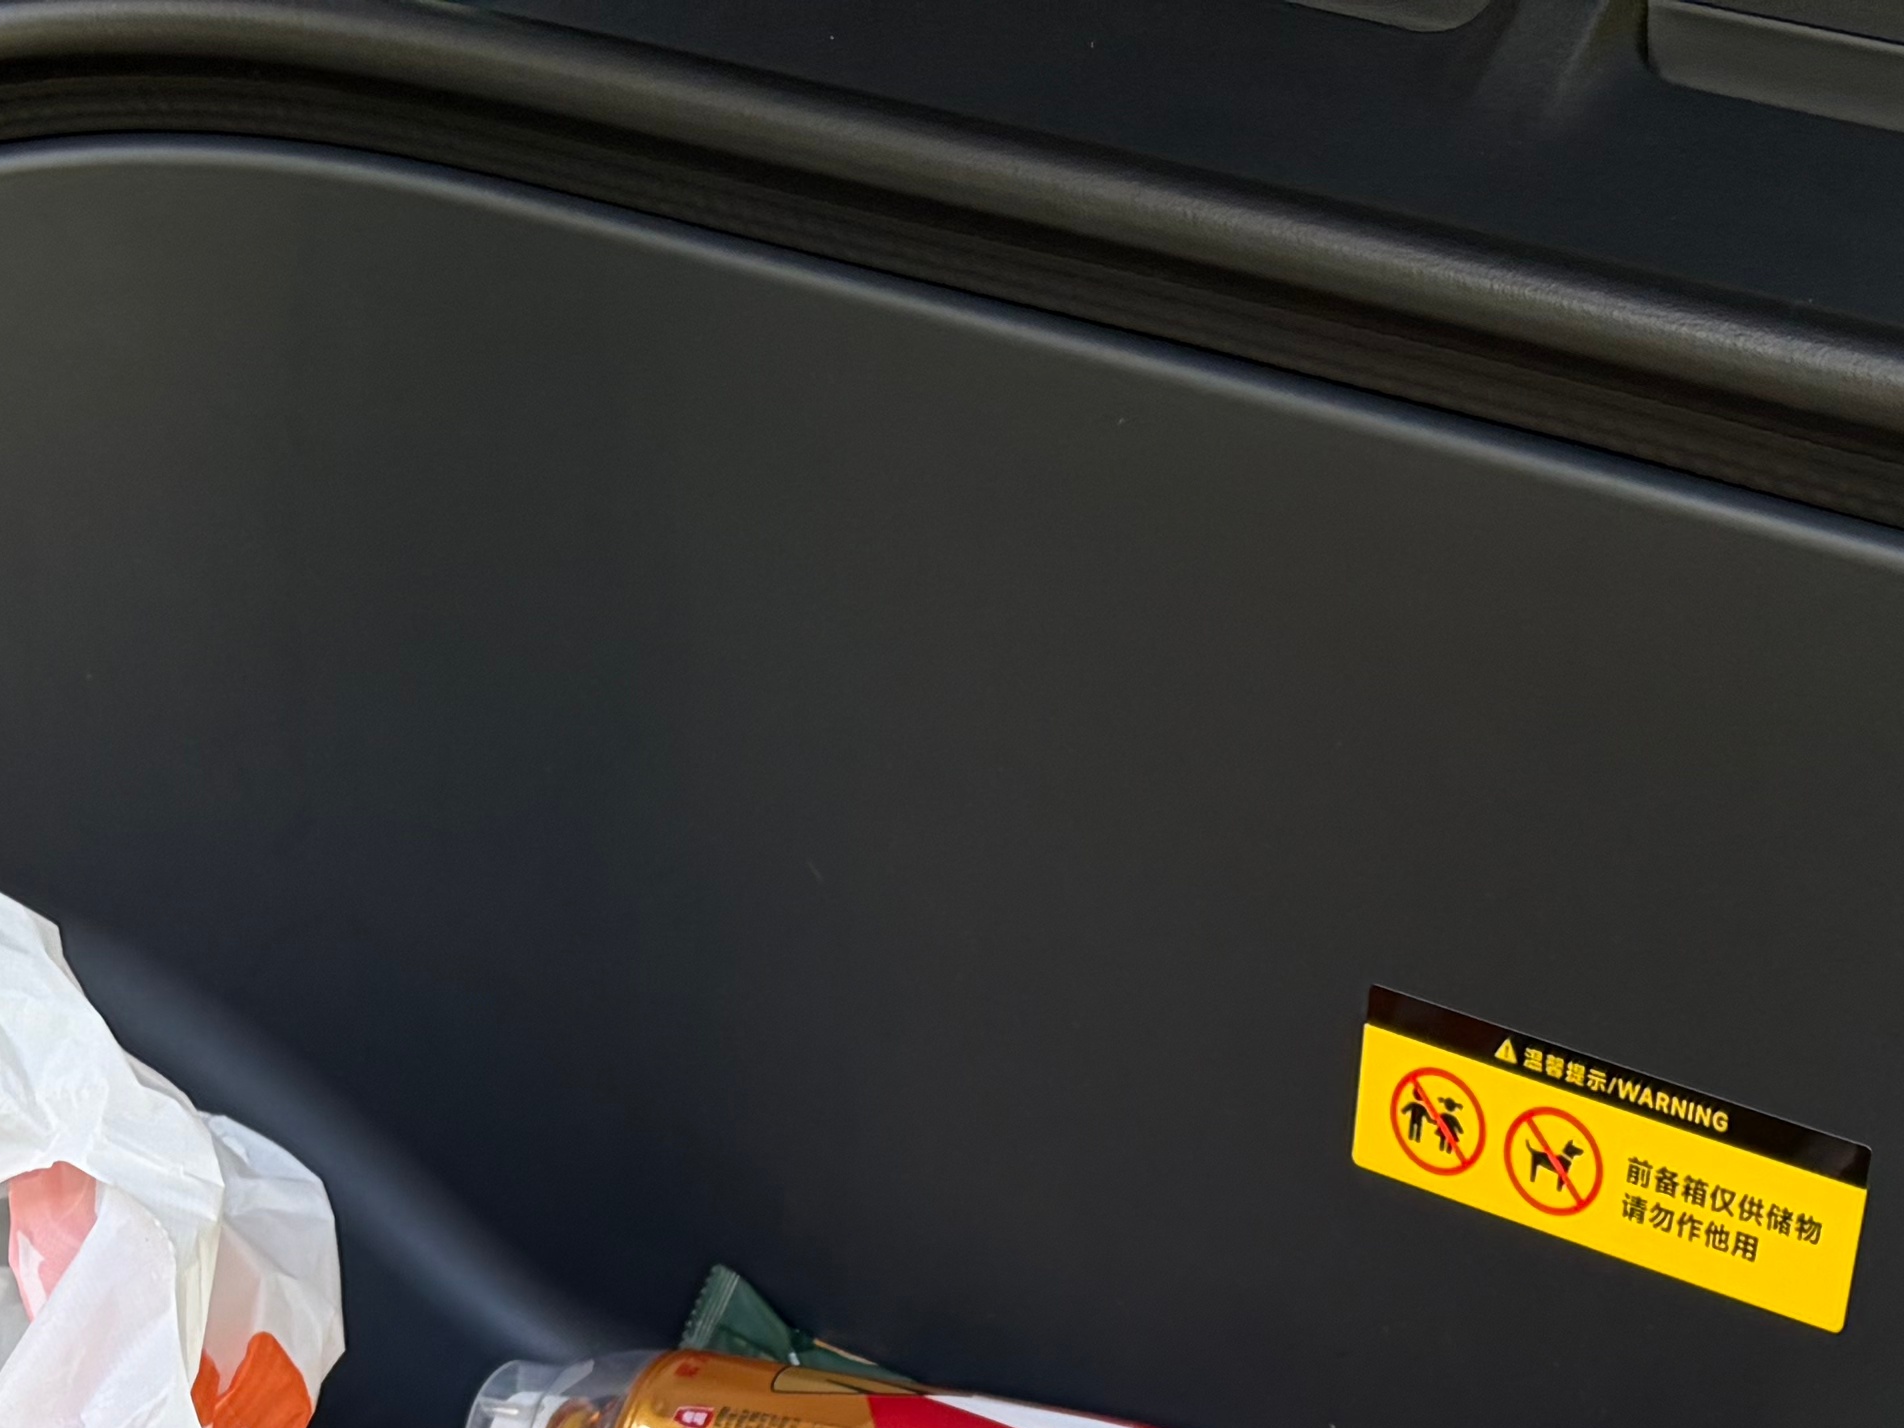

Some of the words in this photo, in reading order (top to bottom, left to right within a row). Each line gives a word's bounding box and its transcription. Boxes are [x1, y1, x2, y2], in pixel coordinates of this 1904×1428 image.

[1522, 1045, 1730, 1134] 温馨提示/WARNING
[1621, 1192, 1759, 1262] 请勿作他用
[1626, 1156, 1823, 1246] 前备箱仅供储物
